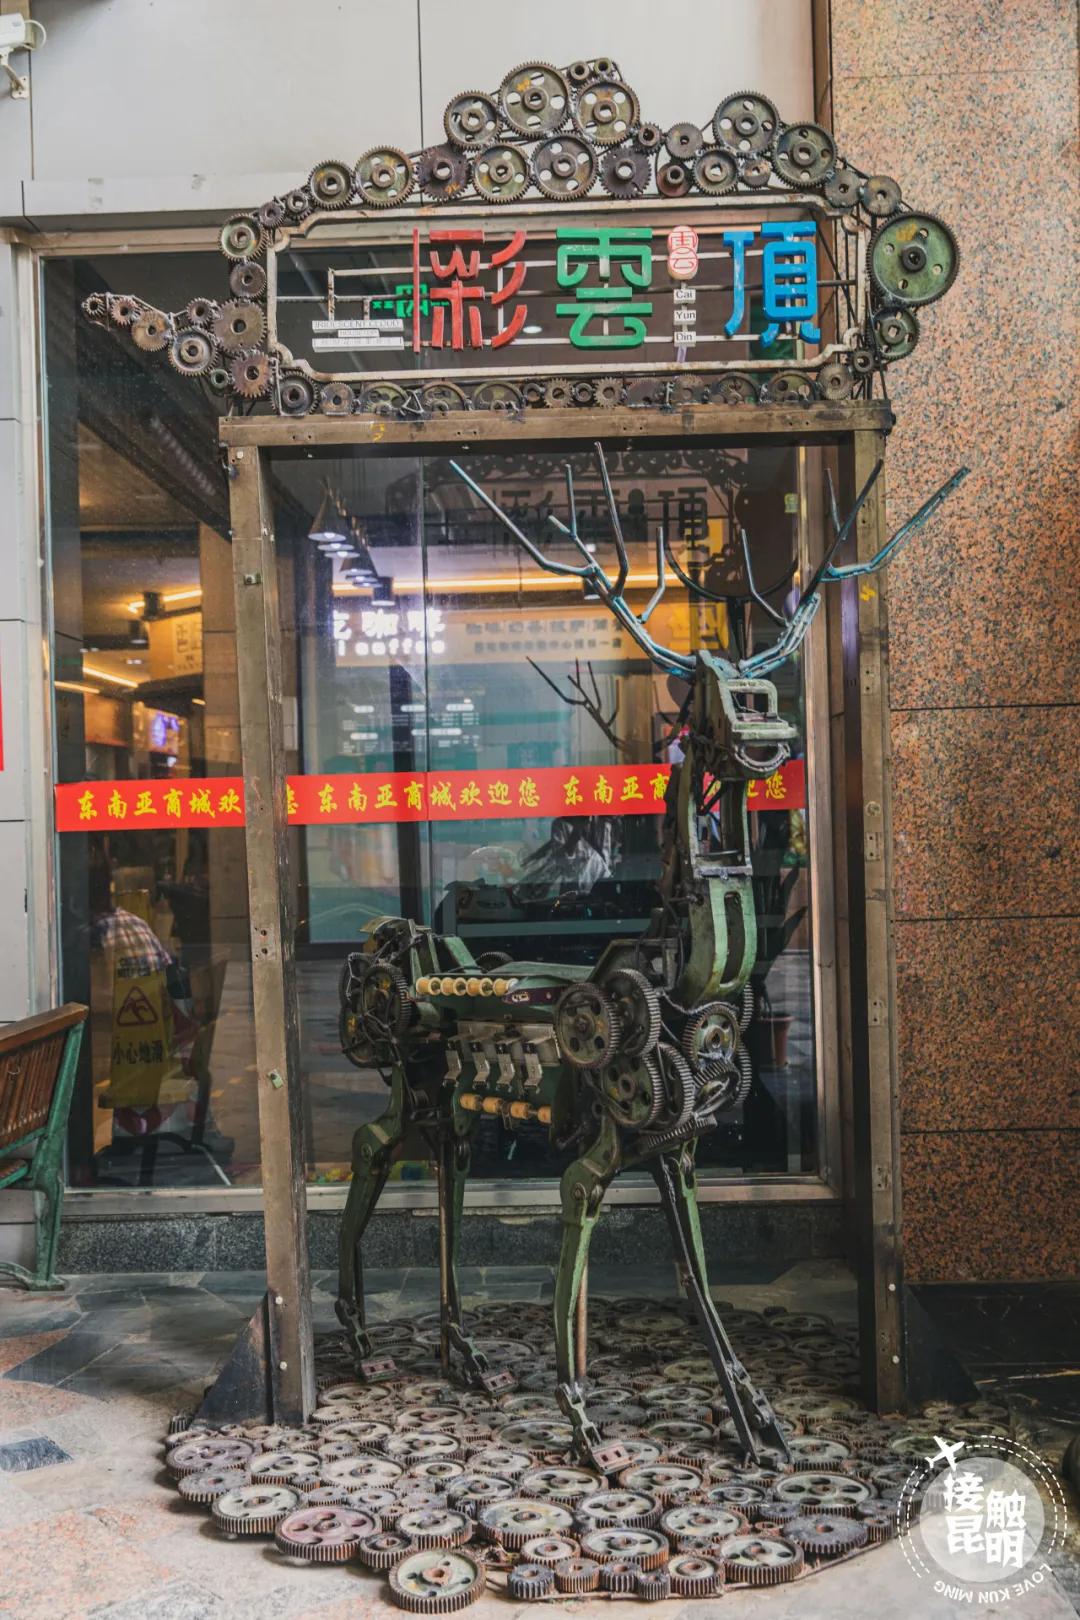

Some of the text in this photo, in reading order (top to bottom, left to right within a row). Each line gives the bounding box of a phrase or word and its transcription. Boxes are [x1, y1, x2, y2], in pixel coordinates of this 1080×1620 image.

[676, 290, 693, 299] Cai
[676, 311, 696, 320] Yun
[676, 332, 693, 342] Din
[318, 777, 540, 814] 东南亚商城欢迎您
